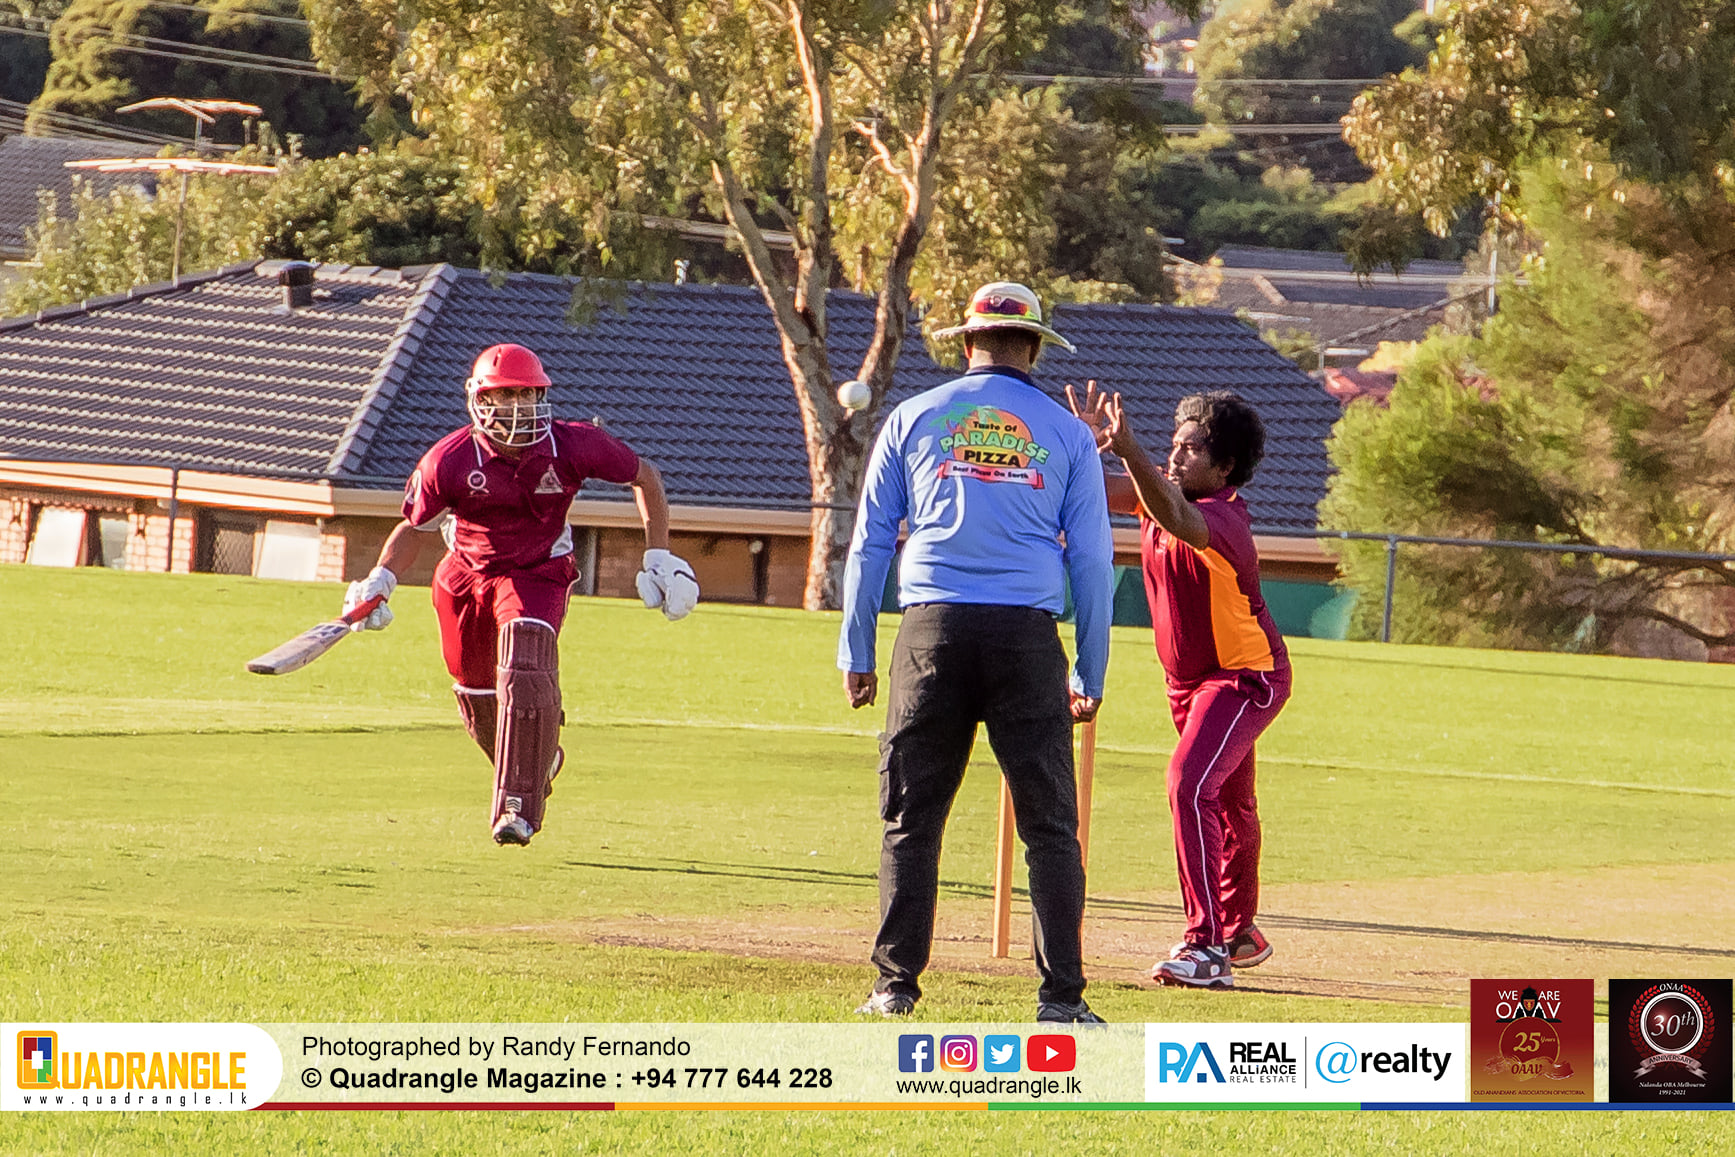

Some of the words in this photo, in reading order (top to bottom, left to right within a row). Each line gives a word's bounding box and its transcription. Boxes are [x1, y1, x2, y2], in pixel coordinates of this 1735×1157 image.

[973, 421, 1000, 430] Taste
[1004, 424, 1018, 432] Of
[939, 430, 1050, 464] PARADISE
[964, 450, 1021, 468] PIZZA
